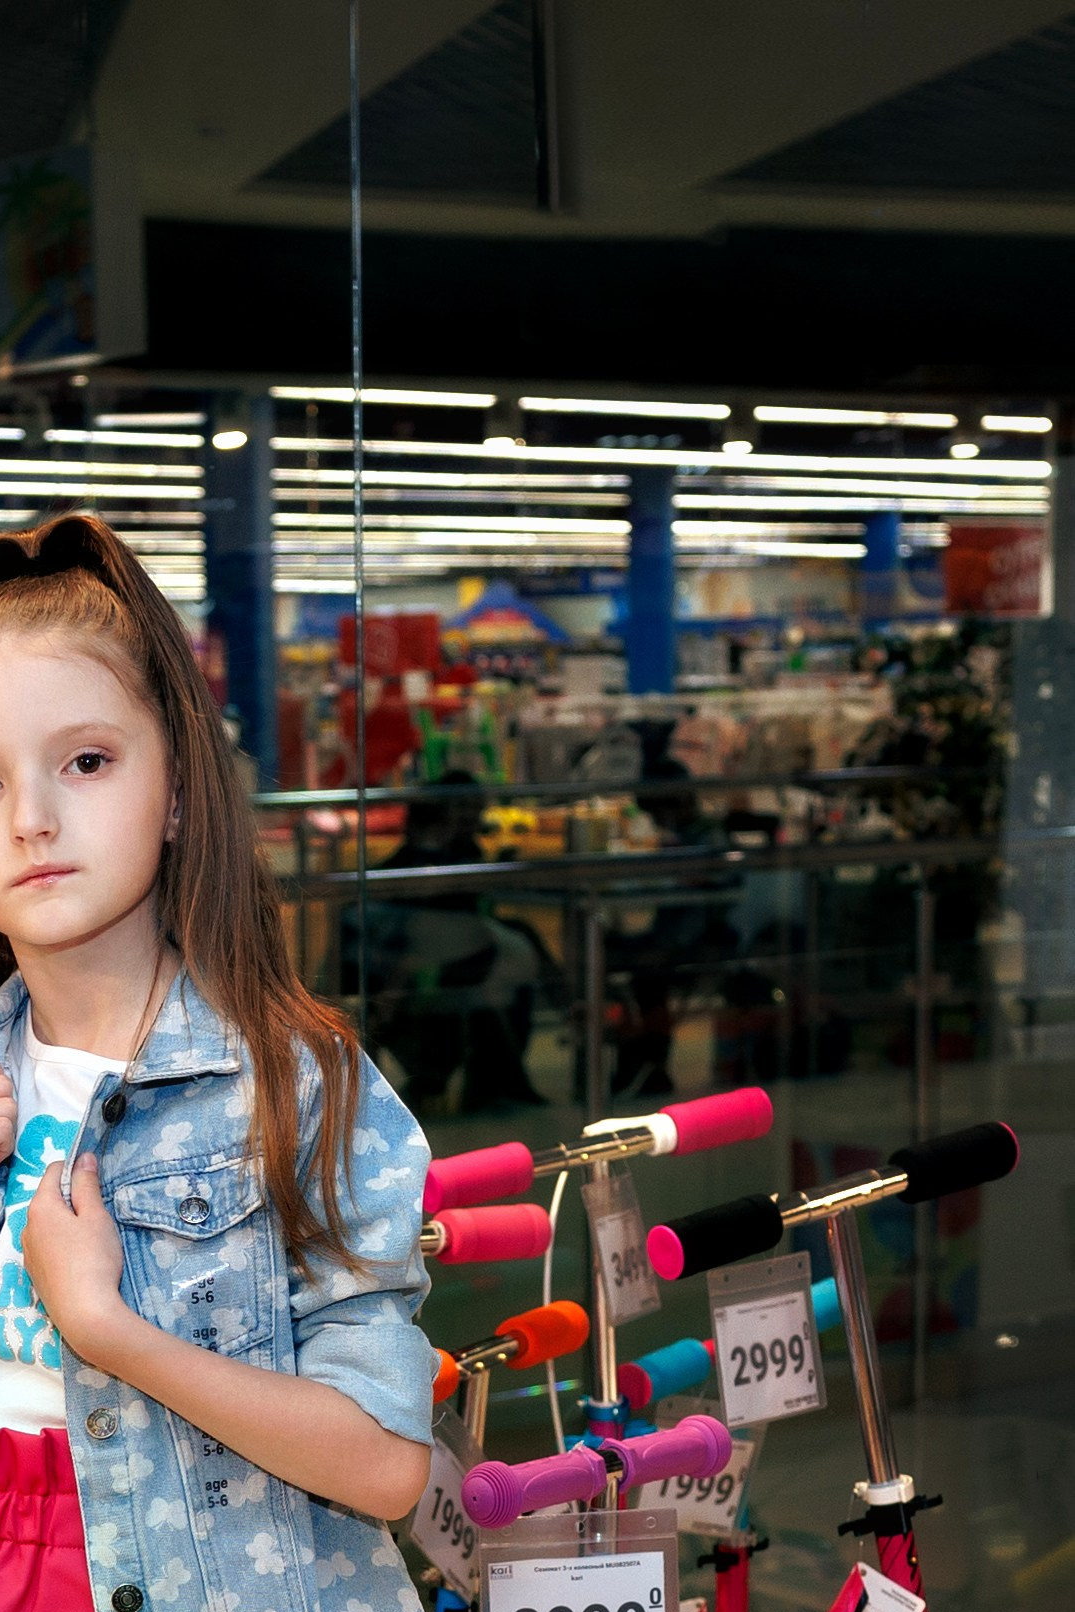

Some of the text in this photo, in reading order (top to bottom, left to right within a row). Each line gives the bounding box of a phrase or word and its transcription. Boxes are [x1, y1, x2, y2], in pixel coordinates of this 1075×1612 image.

[191, 1291, 214, 1304] 5-6
[192, 1327, 218, 1340] age
[730, 1334, 805, 1387] 2999
[203, 1443, 224, 1457] 5-6
[205, 1479, 228, 1492] age
[207, 1495, 229, 1508] 5-6
[431, 1487, 475, 1560] 1999
[491, 1564, 512, 1575] kari
[650, 1587, 662, 1608] 0
